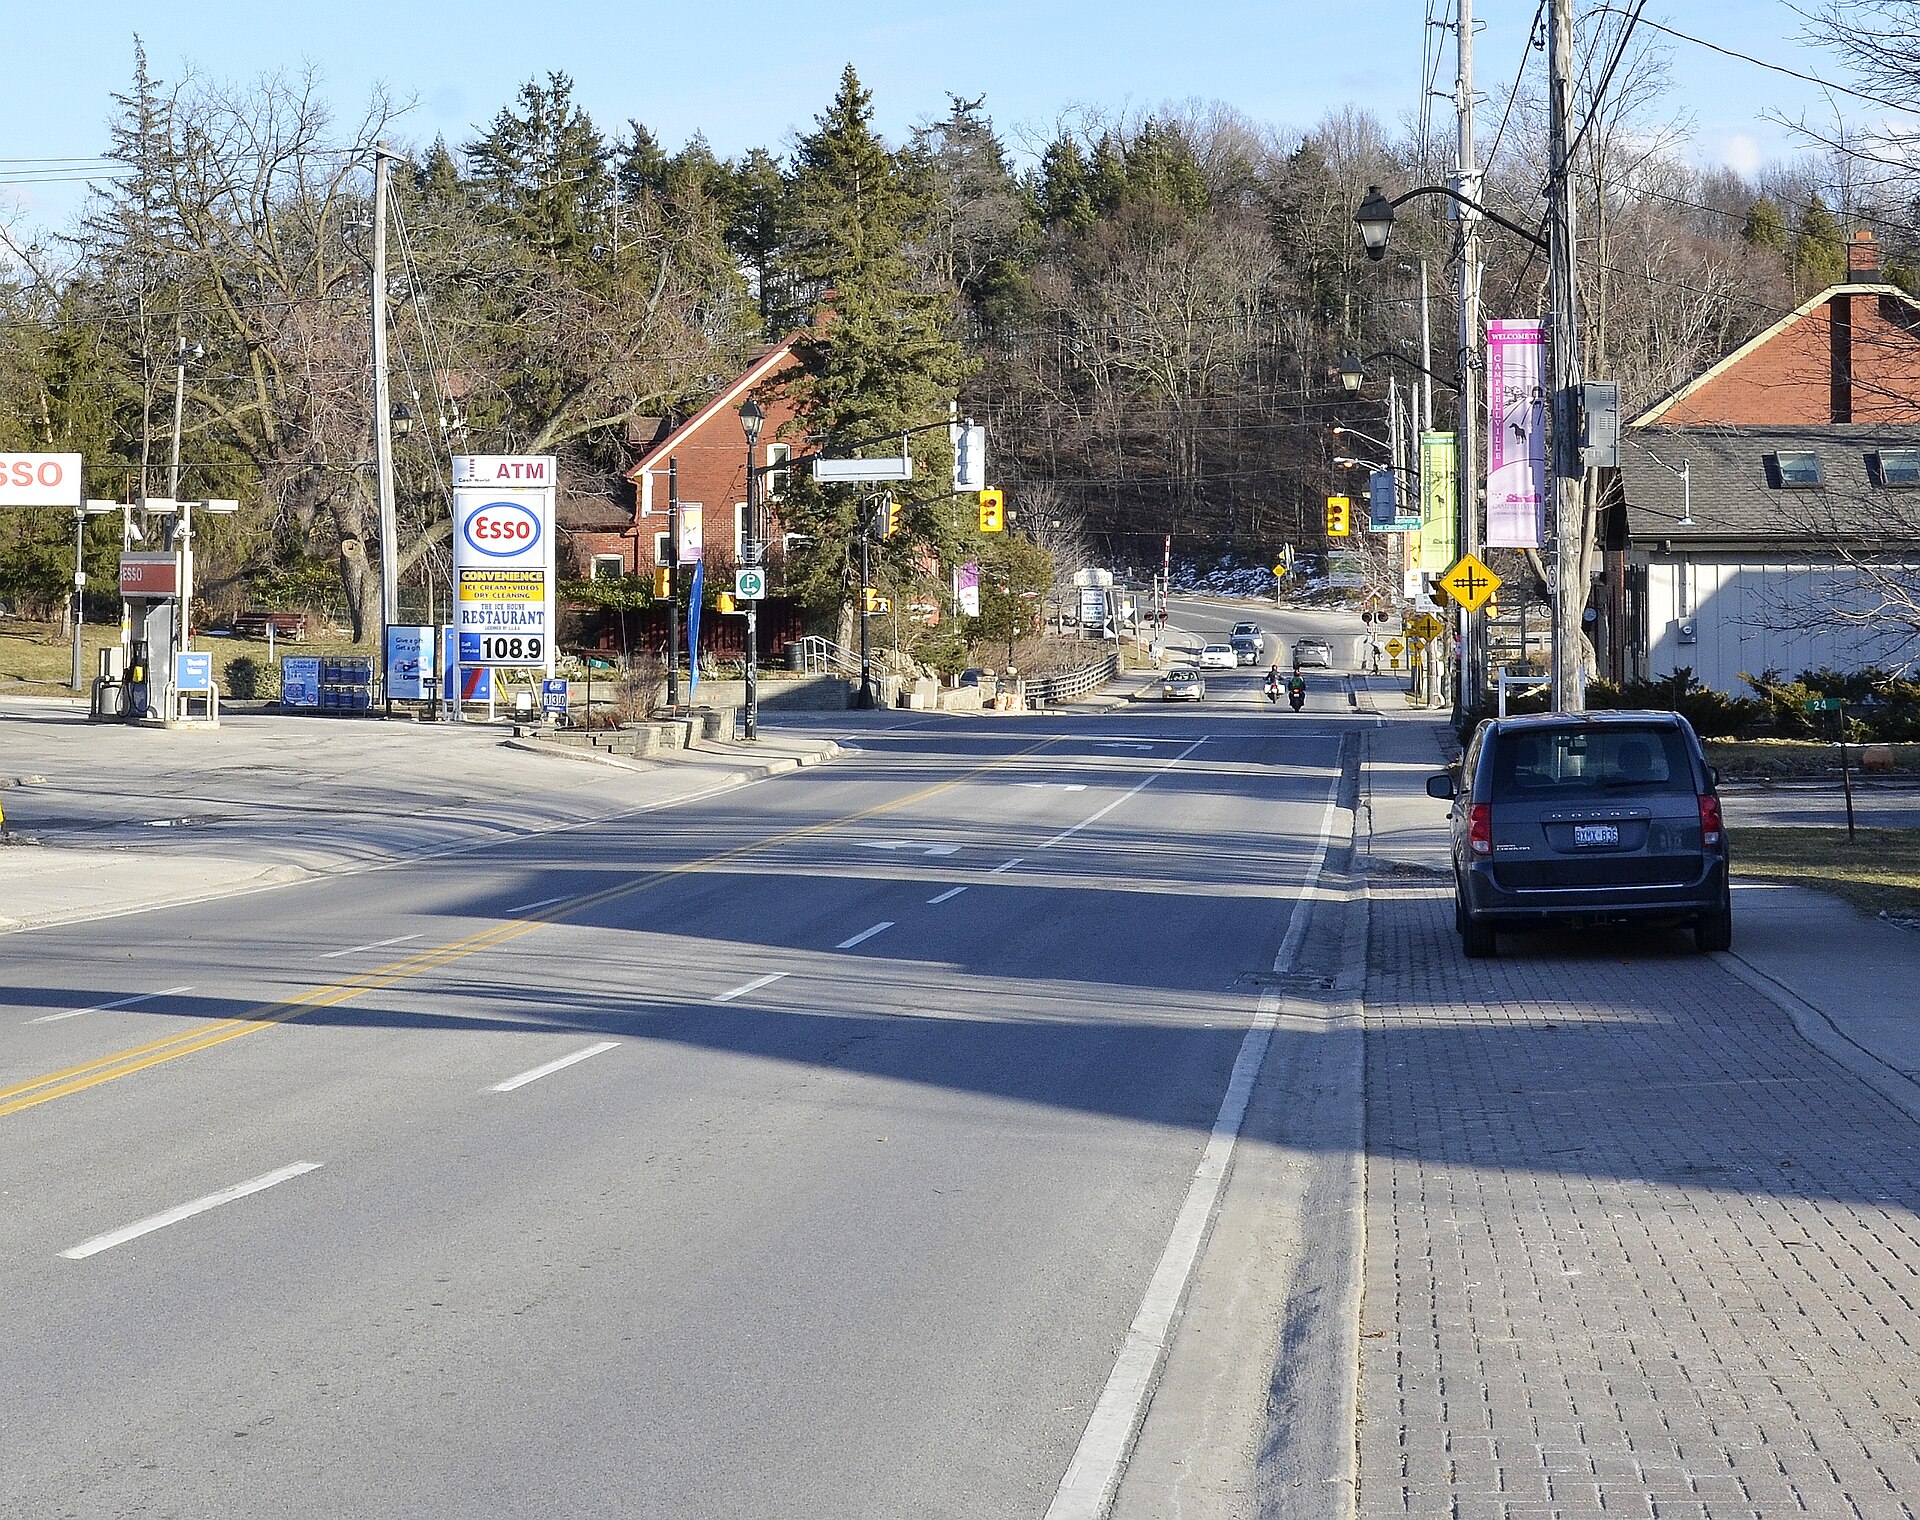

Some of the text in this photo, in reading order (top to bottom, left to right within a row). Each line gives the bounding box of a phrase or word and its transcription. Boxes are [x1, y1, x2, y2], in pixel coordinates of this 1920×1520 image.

[1491, 333, 1528, 341] WELCOME
[1493, 354, 1502, 460] CAMPBELLVILLE
[496, 463, 544, 479] ATM
[461, 571, 544, 582] CONVENIENCE
[462, 610, 545, 625] RESTAURANT
[483, 637, 541, 659] 108.9
[1813, 700, 1827, 710] 24
